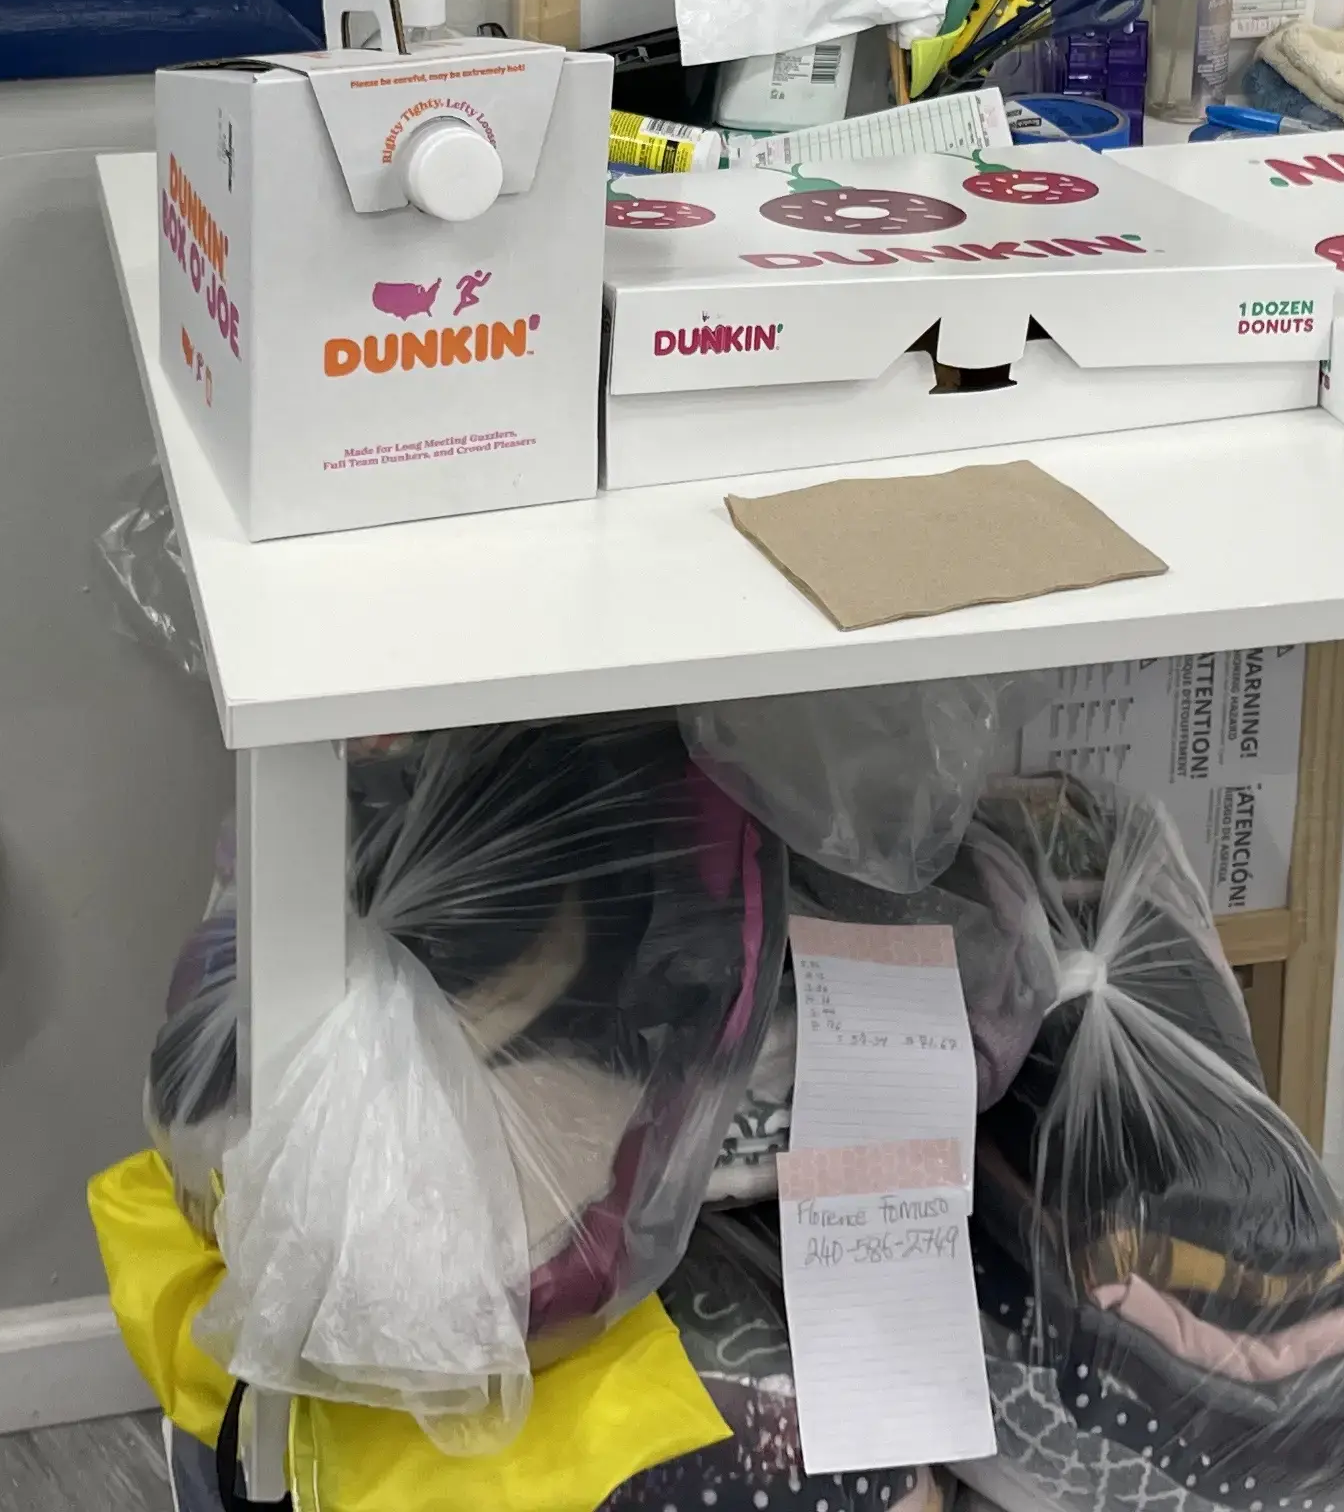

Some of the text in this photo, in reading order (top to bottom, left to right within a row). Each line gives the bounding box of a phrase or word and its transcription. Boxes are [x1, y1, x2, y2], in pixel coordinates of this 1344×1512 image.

[350, 63, 526, 89] Please be careful, may be extremely hot!
[382, 120, 404, 164] Righty
[446, 98, 478, 117] Lefty
[476, 113, 497, 150] Loose
[161, 187, 188, 274] BOX
[206, 271, 241, 361] JOE
[1238, 299, 1314, 317] 1 DOZEN
[1237, 317, 1314, 335] DONUTS
[323, 436, 537, 472] Full Team Dunkers, and Crowd Pleasers
[344, 447, 375, 459] Made
[376, 444, 393, 455] for
[395, 441, 423, 453] Long
[424, 436, 468, 449] Meeting
